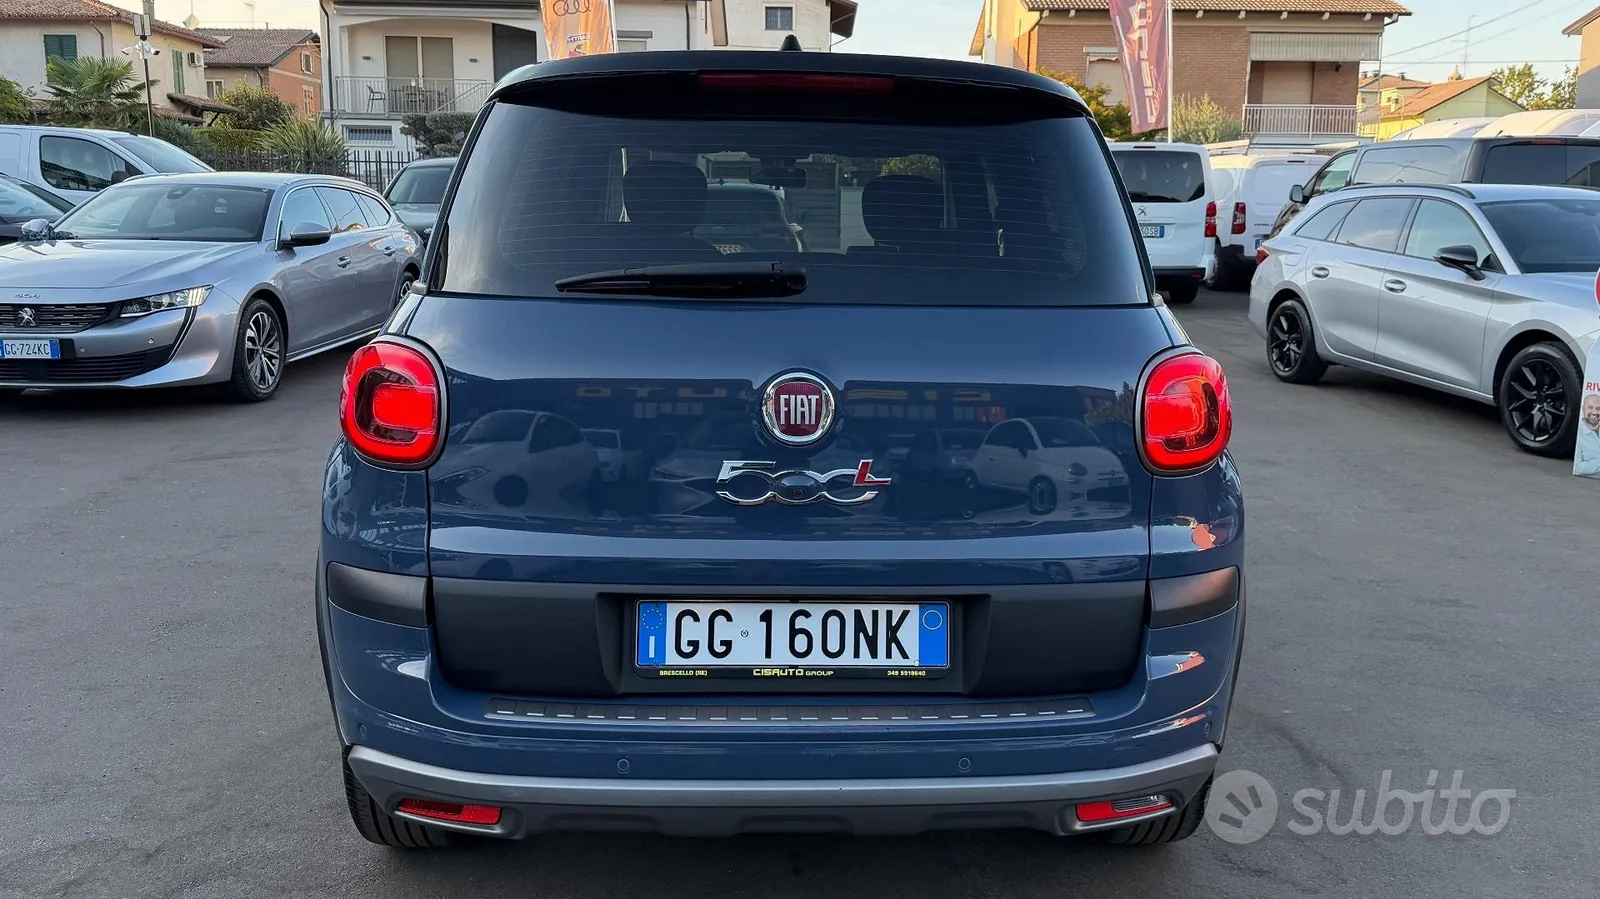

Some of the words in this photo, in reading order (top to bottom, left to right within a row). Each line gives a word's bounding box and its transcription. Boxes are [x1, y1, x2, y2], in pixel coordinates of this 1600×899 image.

[779, 394, 819, 425] FIAT
[674, 608, 734, 660] GG
[759, 608, 911, 660] 160NK
[752, 668, 804, 676] CISAUTO
